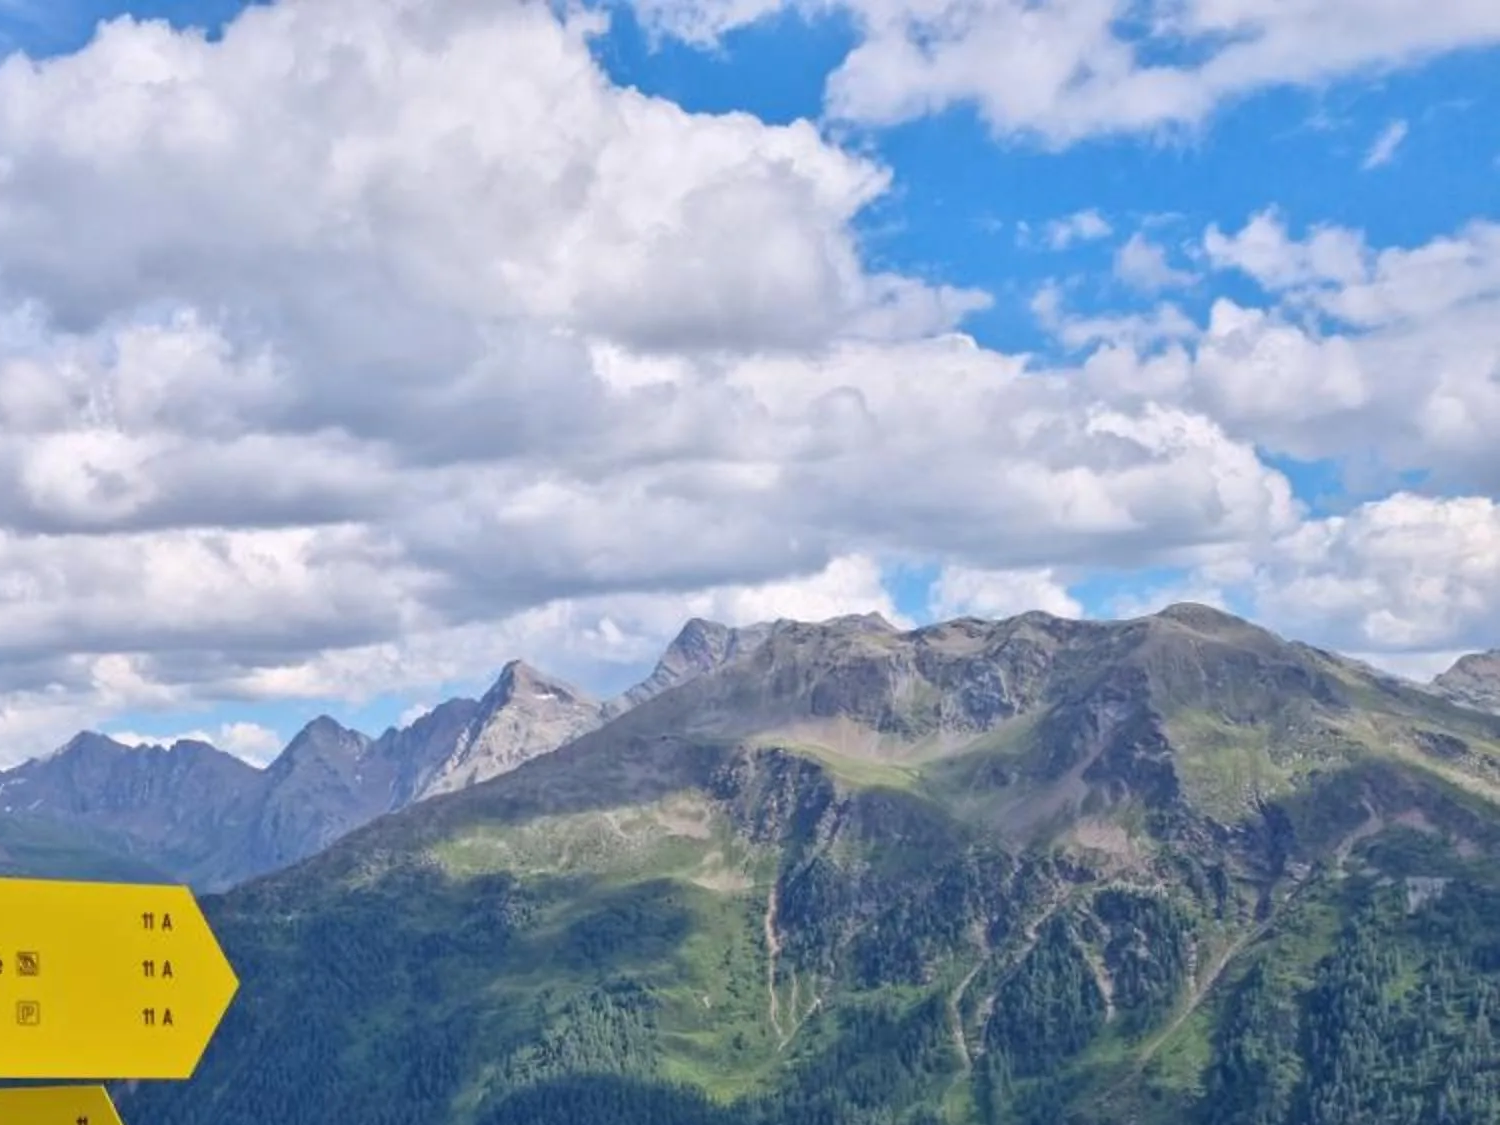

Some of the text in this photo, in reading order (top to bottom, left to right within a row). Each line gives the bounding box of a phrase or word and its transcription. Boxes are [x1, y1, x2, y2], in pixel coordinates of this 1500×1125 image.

[142, 912, 172, 931] 11 A
[142, 960, 173, 978] 11 A
[142, 1009, 173, 1026] 11 A
